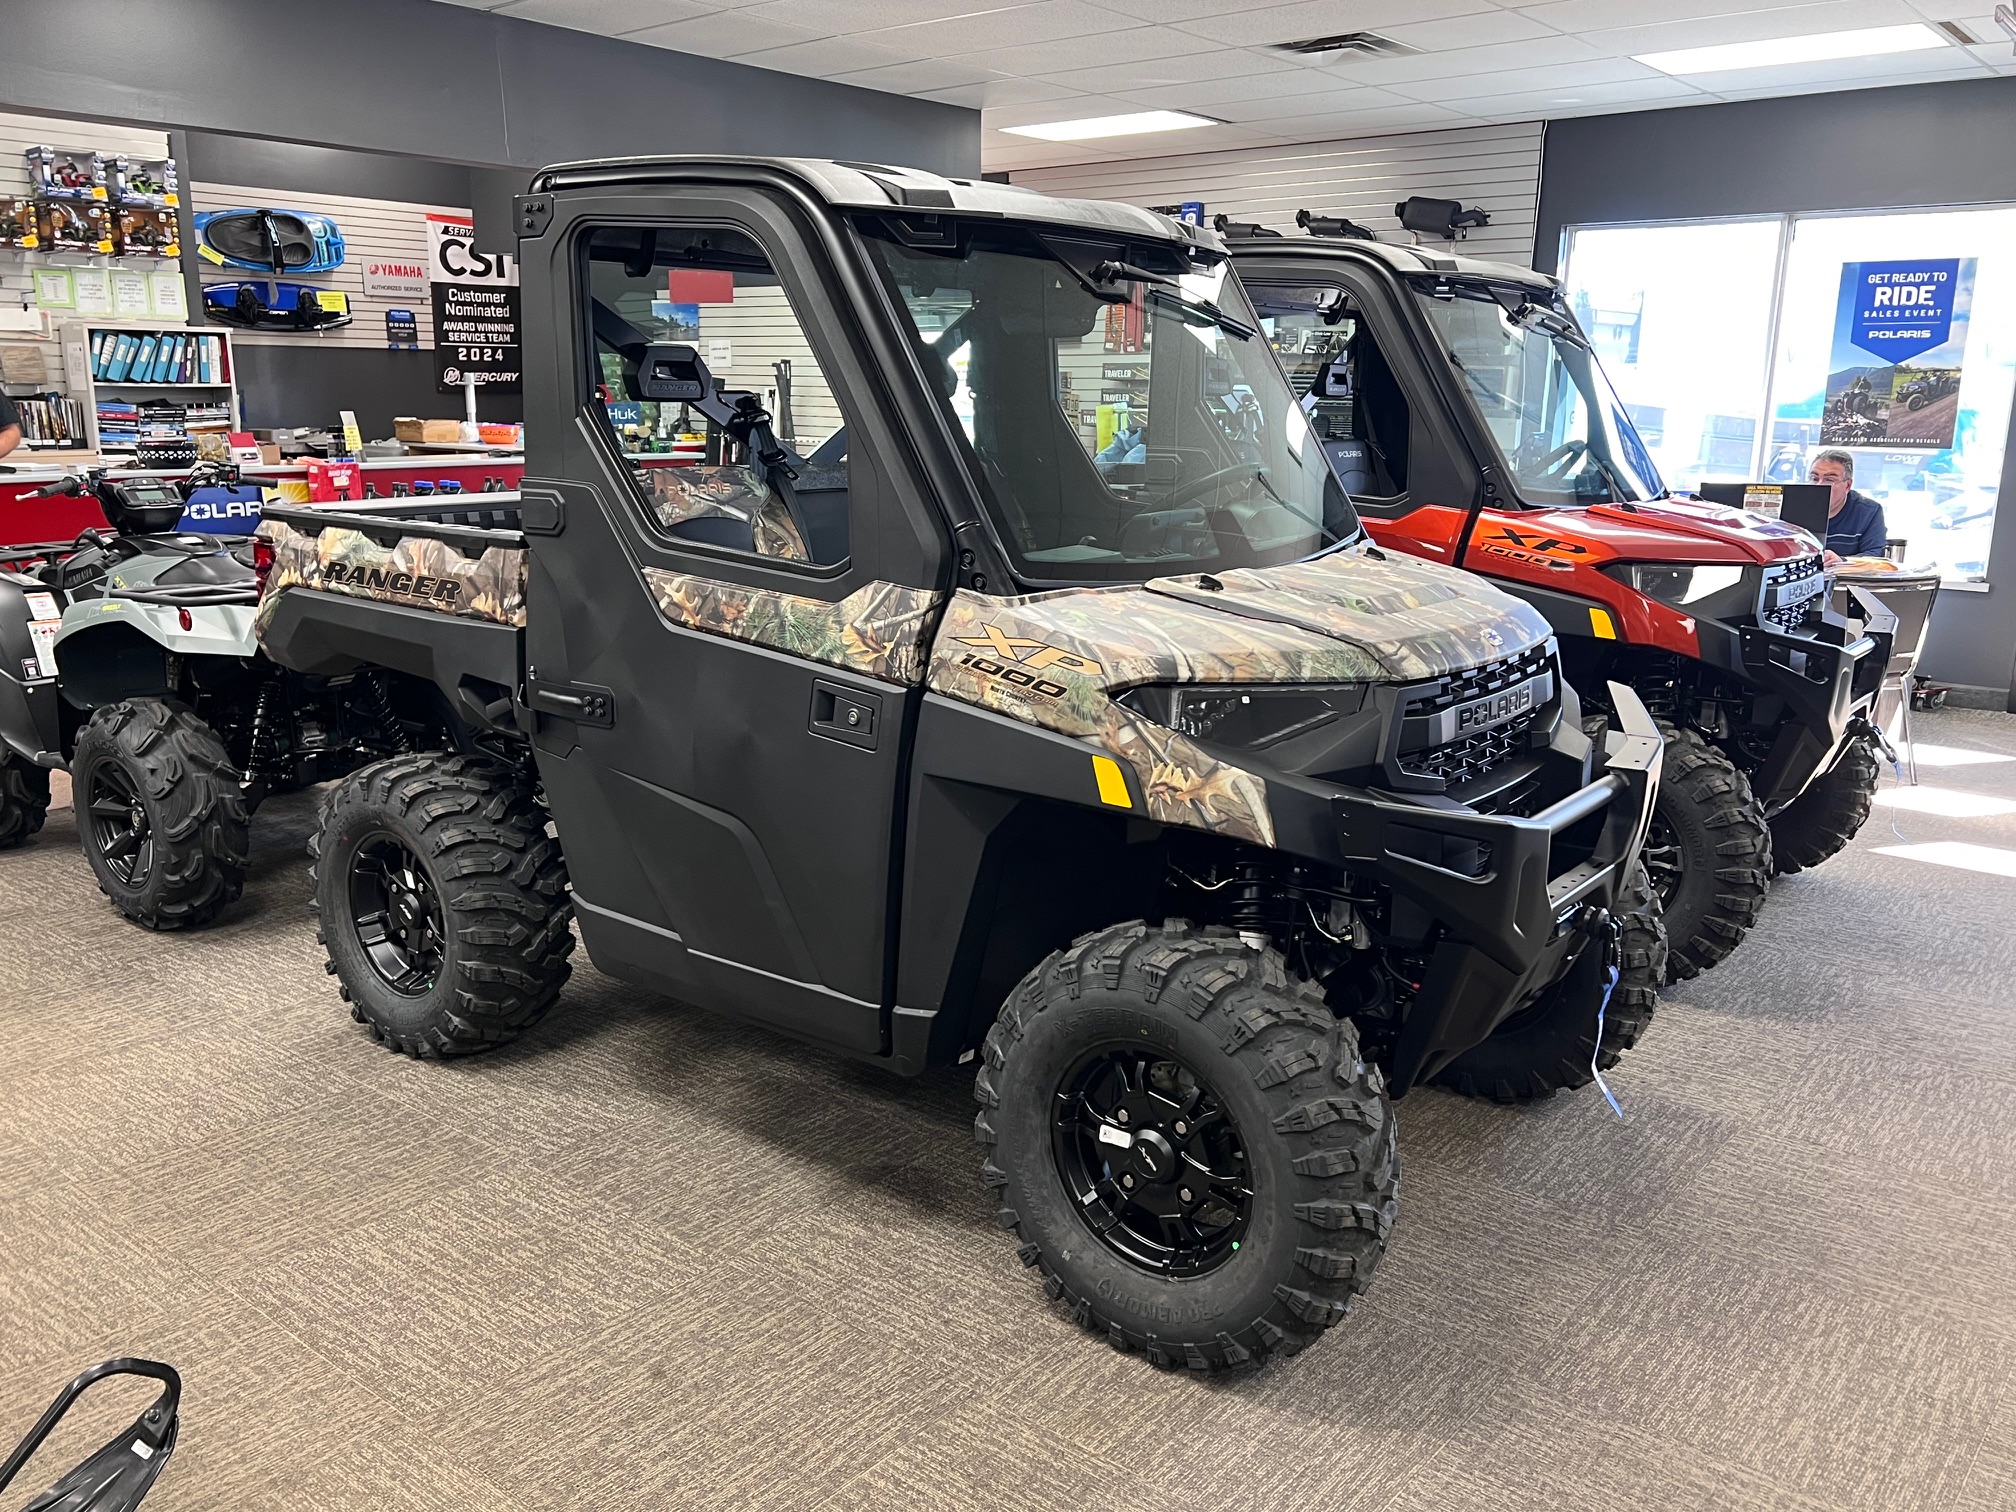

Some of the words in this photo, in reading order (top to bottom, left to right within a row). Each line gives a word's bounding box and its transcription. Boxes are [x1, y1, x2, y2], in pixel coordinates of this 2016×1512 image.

[380, 264, 423, 279] YAMAHA
[1868, 273, 1891, 284] GET
[1891, 272, 1931, 283] READY
[1932, 272, 1948, 282] TO
[371, 284, 403, 292] AUTHORIZED
[448, 288, 506, 304] Customer
[1873, 285, 1937, 308] RIDE
[445, 303, 510, 318] Nominated
[1863, 310, 1900, 318] SALES
[1905, 308, 1943, 317] EVENT
[443, 321, 475, 332] AWARD
[476, 322, 515, 333] WINNING
[1868, 329, 1932, 339] POLARIS
[448, 332, 486, 342] SERVICE
[487, 333, 511, 343] TEAM
[458, 347, 504, 362] 2024
[462, 372, 519, 381] ERCURY
[1104, 369, 1132, 379] TRAVELER
[1102, 393, 1130, 403] TRAVELER
[608, 408, 638, 420] Huk
[666, 482, 732, 496] POLARIS
[1483, 526, 1588, 554] XP
[1480, 542, 1554, 567] 1000
[322, 561, 462, 603] RANGER
[947, 621, 1104, 676] XP
[959, 652, 1068, 699] 1000
[1459, 684, 1530, 733] POLARIS
